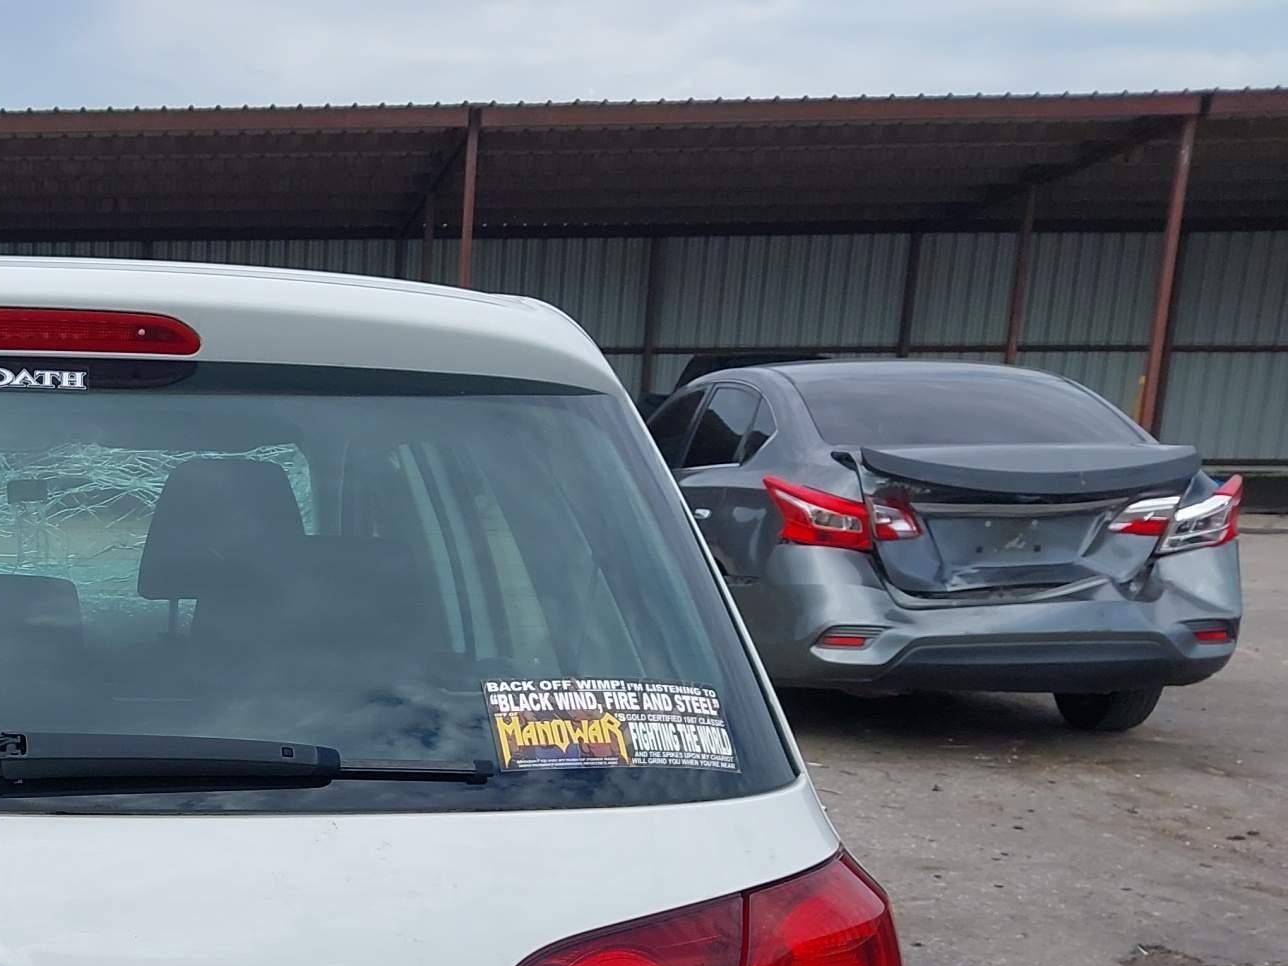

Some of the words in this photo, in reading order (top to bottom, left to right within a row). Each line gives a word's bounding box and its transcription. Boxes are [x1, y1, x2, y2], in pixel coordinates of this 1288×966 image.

[486, 681, 535, 692] BACK
[539, 680, 572, 690] OFF
[576, 680, 626, 691] WIMP!
[645, 684, 701, 696] LISTENING
[702, 689, 716, 698] TO
[553, 691, 603, 713] WIND,
[603, 691, 640, 711] FIRE
[642, 692, 672, 712] AND
[626, 713, 646, 721] GOLD
[647, 714, 682, 723] CERTIFIED
[698, 717, 725, 727] CLASSIC
[628, 722, 680, 752] FIGHTING
[676, 723, 702, 753] THE
[697, 726, 732, 756] WORLD
